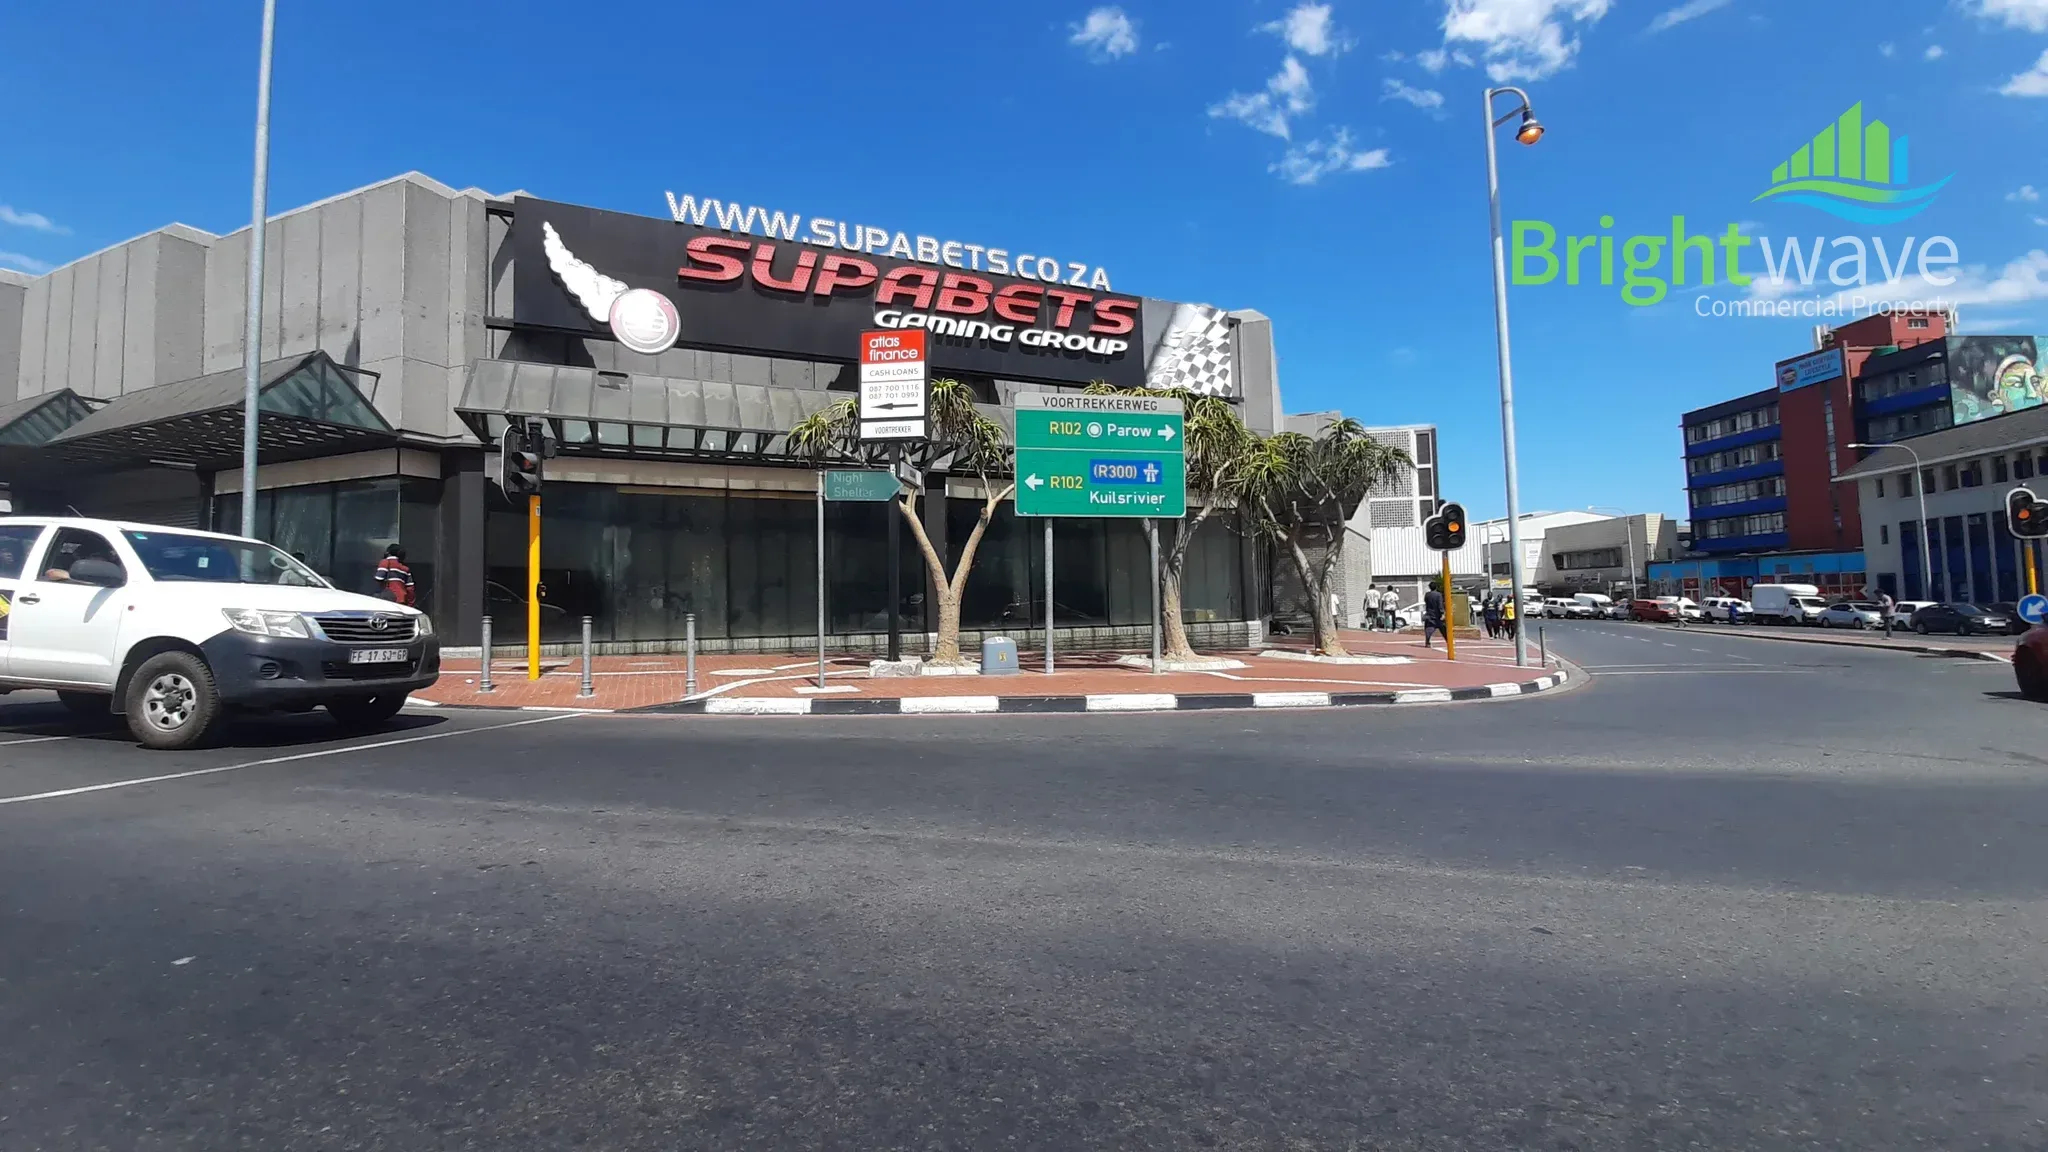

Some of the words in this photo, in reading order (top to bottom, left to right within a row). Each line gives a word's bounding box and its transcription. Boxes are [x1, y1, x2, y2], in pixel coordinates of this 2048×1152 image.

[665, 191, 1112, 292] WWW.SUPABETS.CO.ZA
[678, 236, 1139, 334] SUPABETS
[874, 309, 1014, 342] GAMING
[1018, 328, 1128, 355] GROUP
[869, 336, 900, 348] atlas
[869, 349, 918, 361] finance
[869, 369, 891, 377] CASH
[892, 368, 919, 376] LOANS
[1042, 396, 1158, 411] VOORTREKKERWEG
[875, 426, 912, 435] VOORTREKKER
[1049, 421, 1082, 435] R102
[1107, 423, 1152, 437] Parow
[1093, 465, 1138, 479] (R300)
[833, 472, 864, 486] Night
[1050, 476, 1083, 489] R102
[834, 486, 873, 498] Shelter
[1089, 491, 1165, 504] Kuilsrivier
[352, 651, 363, 662] FF
